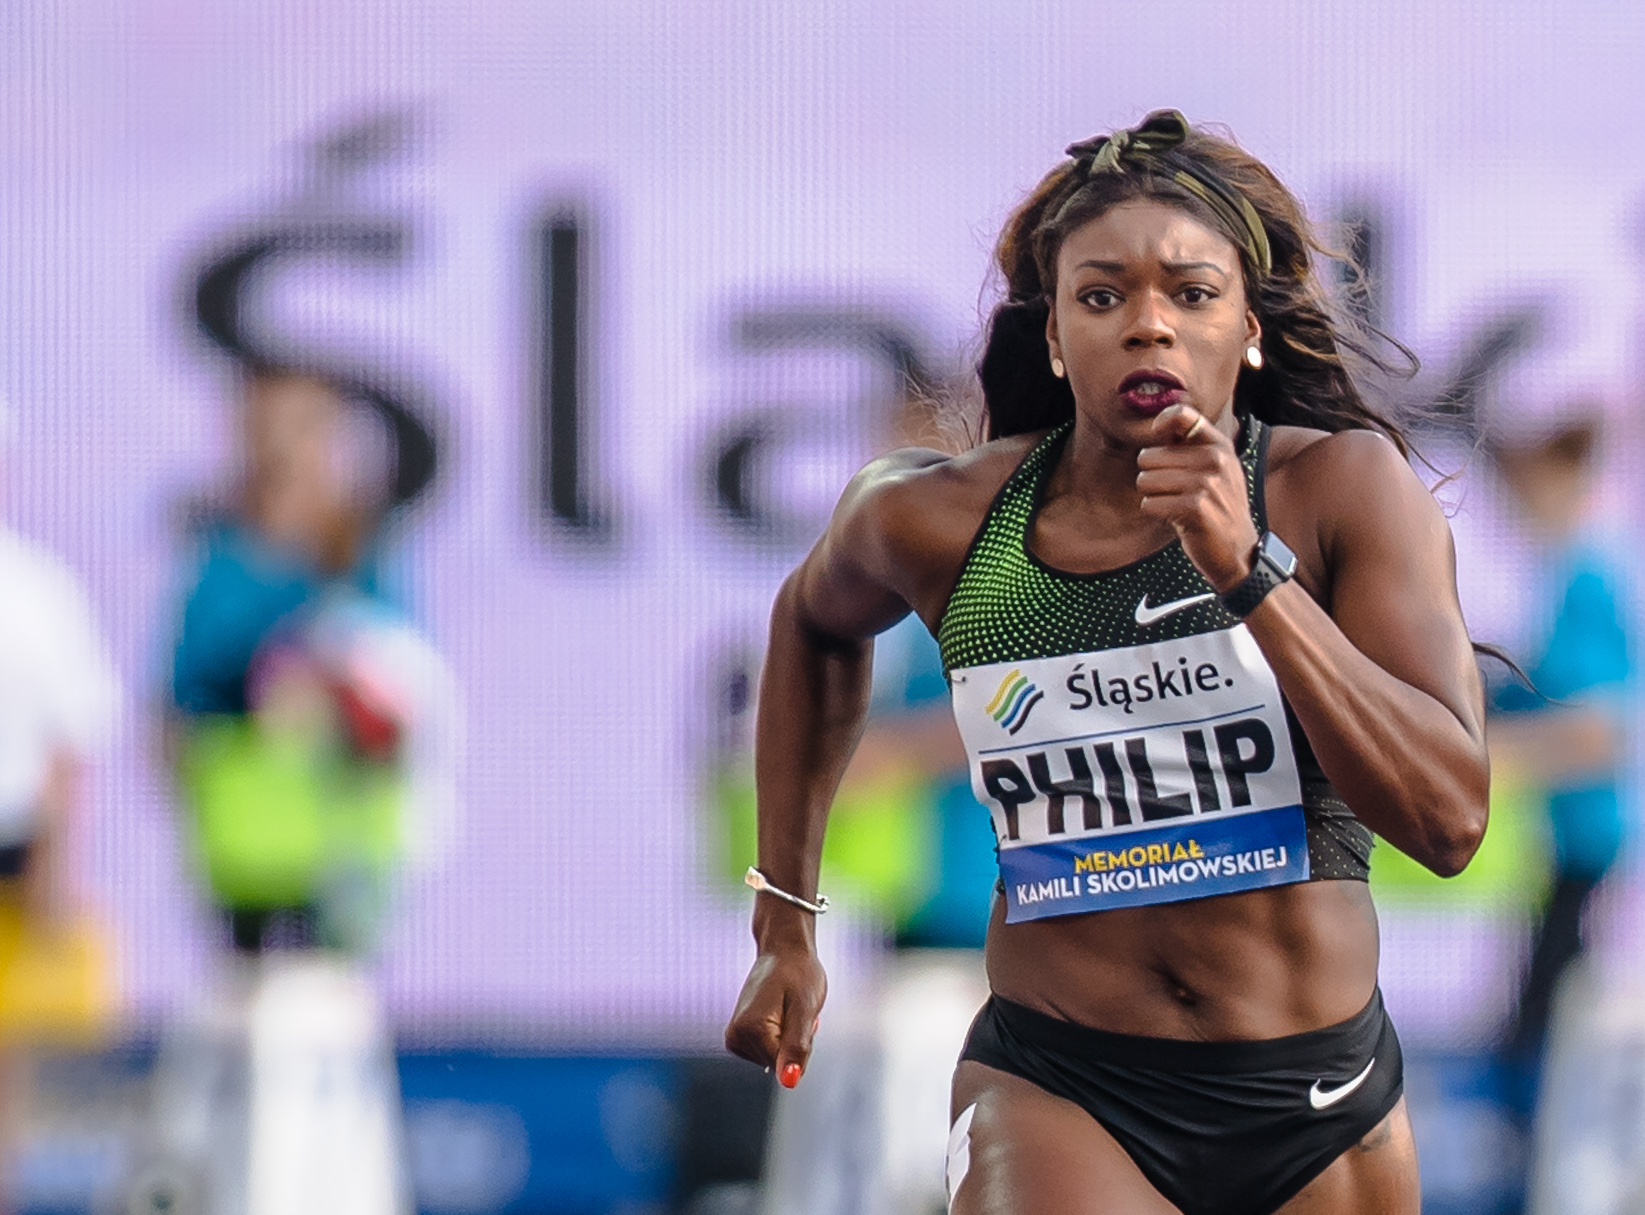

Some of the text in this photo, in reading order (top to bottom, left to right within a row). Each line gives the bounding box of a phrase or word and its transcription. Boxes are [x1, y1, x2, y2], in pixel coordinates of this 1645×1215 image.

[1066, 657, 1234, 714] Śląskie.
[980, 718, 1276, 841] PHILIP
[1016, 846, 1287, 905] KAMILI SKOLIMOWSKIEJ
[1074, 839, 1205, 875] MEMORIAŁ
